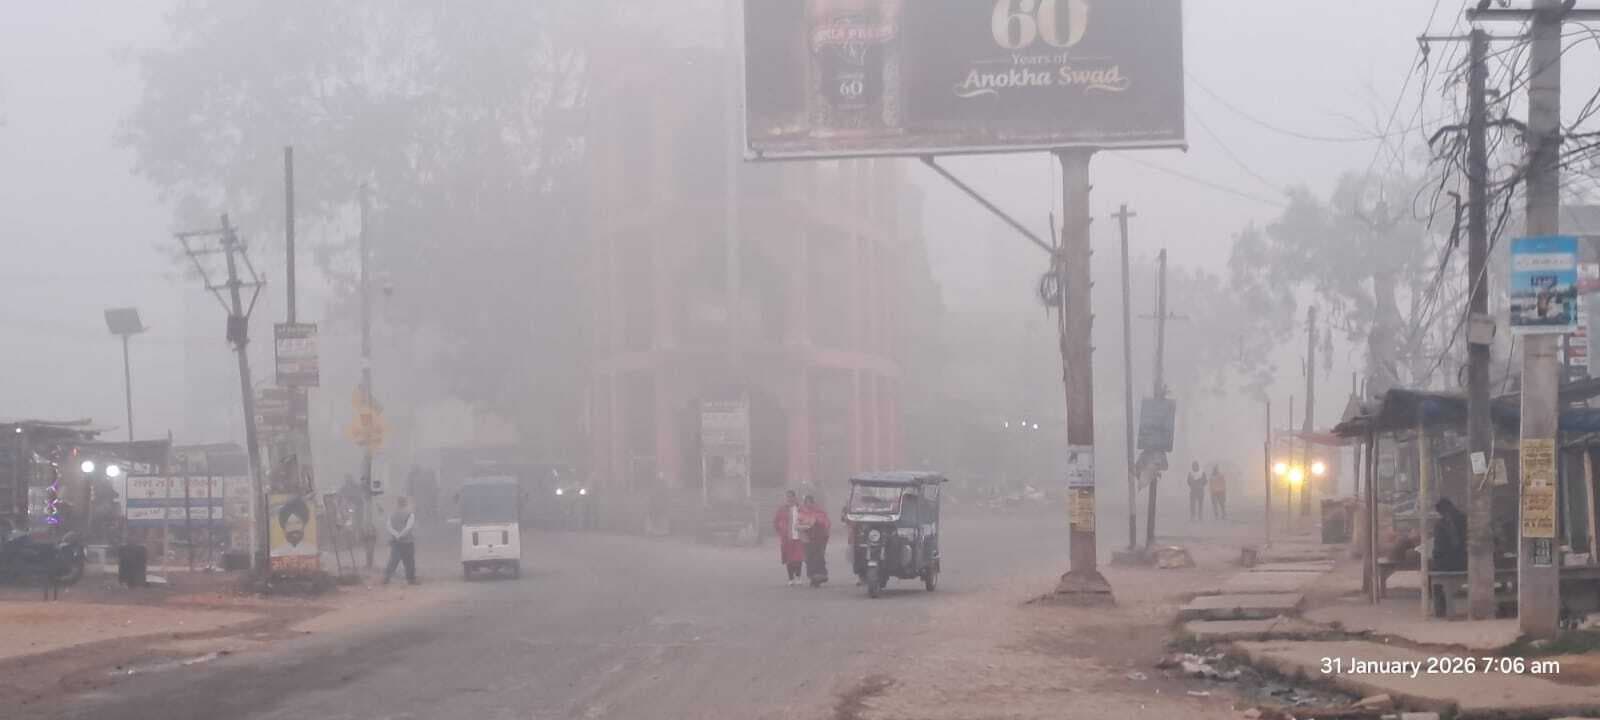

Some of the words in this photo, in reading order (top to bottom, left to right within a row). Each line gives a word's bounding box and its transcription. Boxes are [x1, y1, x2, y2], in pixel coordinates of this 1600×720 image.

[992, 0, 1089, 49] 60
[1011, 53, 1050, 65] Years
[1053, 51, 1068, 65] of
[963, 68, 1051, 88] Anokha
[1058, 65, 1121, 85] Swad
[839, 79, 863, 96] 60
